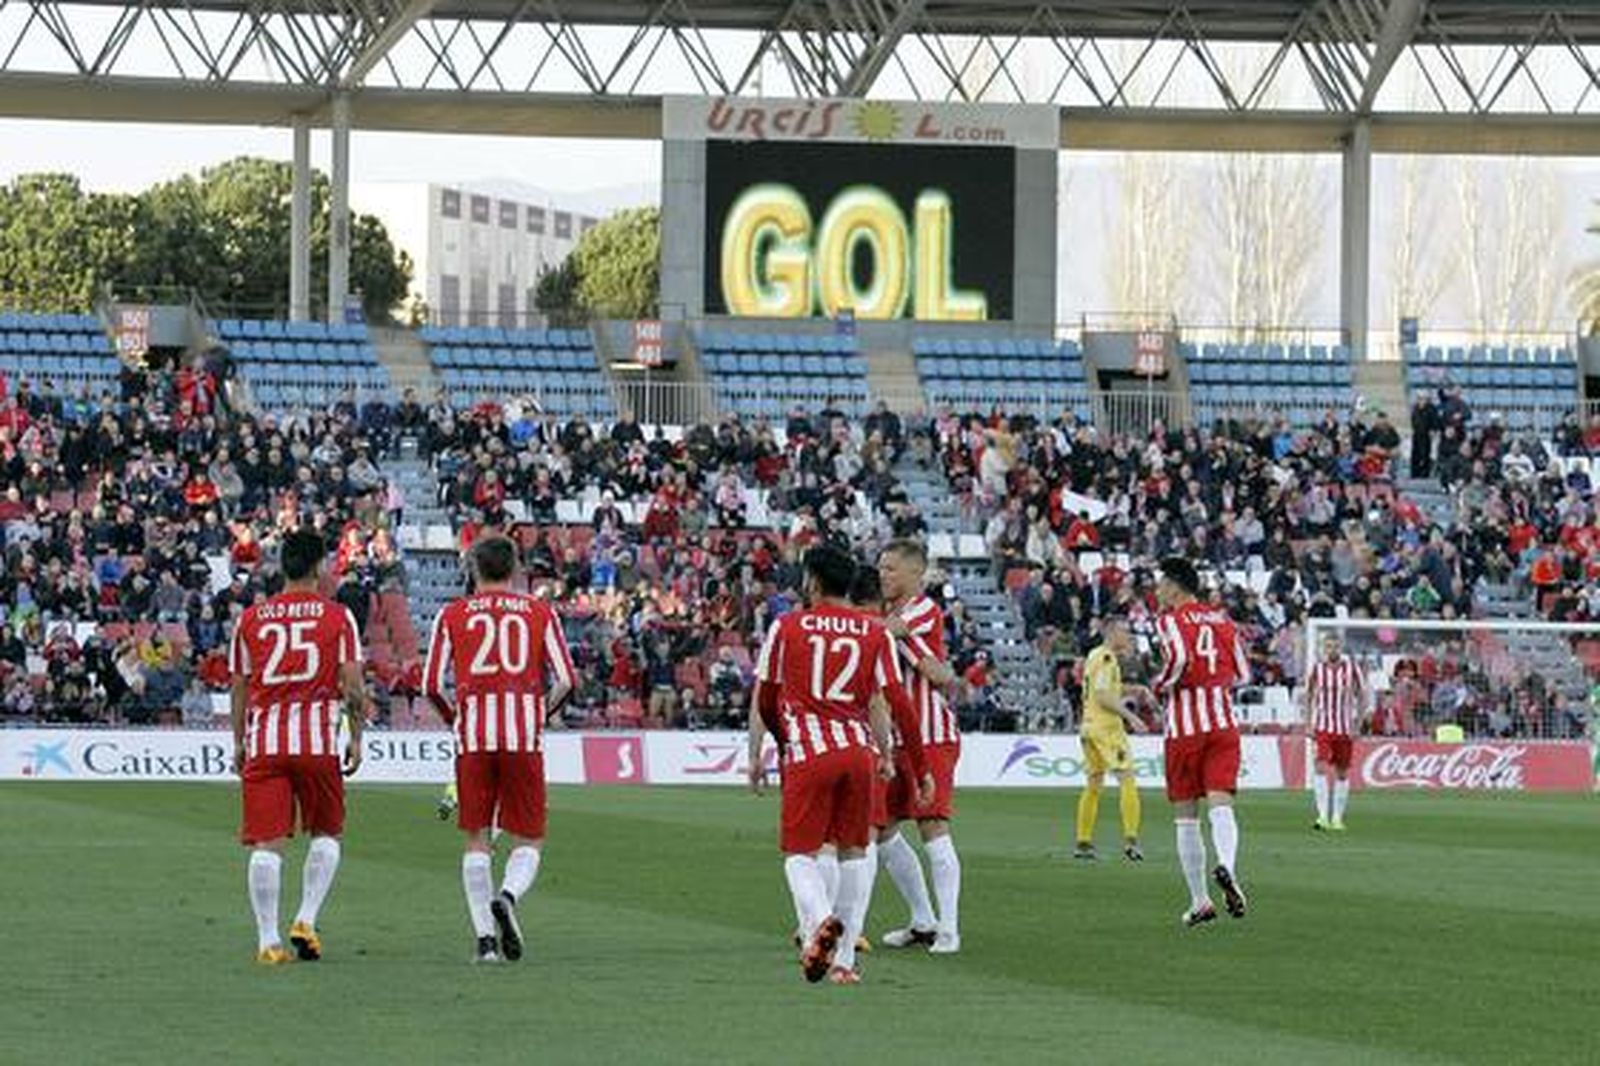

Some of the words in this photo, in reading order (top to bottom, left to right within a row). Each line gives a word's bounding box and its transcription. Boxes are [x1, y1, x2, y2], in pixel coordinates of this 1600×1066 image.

[722, 182, 988, 320] GOL
[257, 621, 320, 685] 25
[467, 613, 531, 675] 20
[801, 614, 869, 636] CHULI
[1196, 624, 1218, 675] 4
[808, 634, 861, 701] 12
[83, 742, 234, 775] CaixaB
[1362, 743, 1527, 790] Coca-Cola
